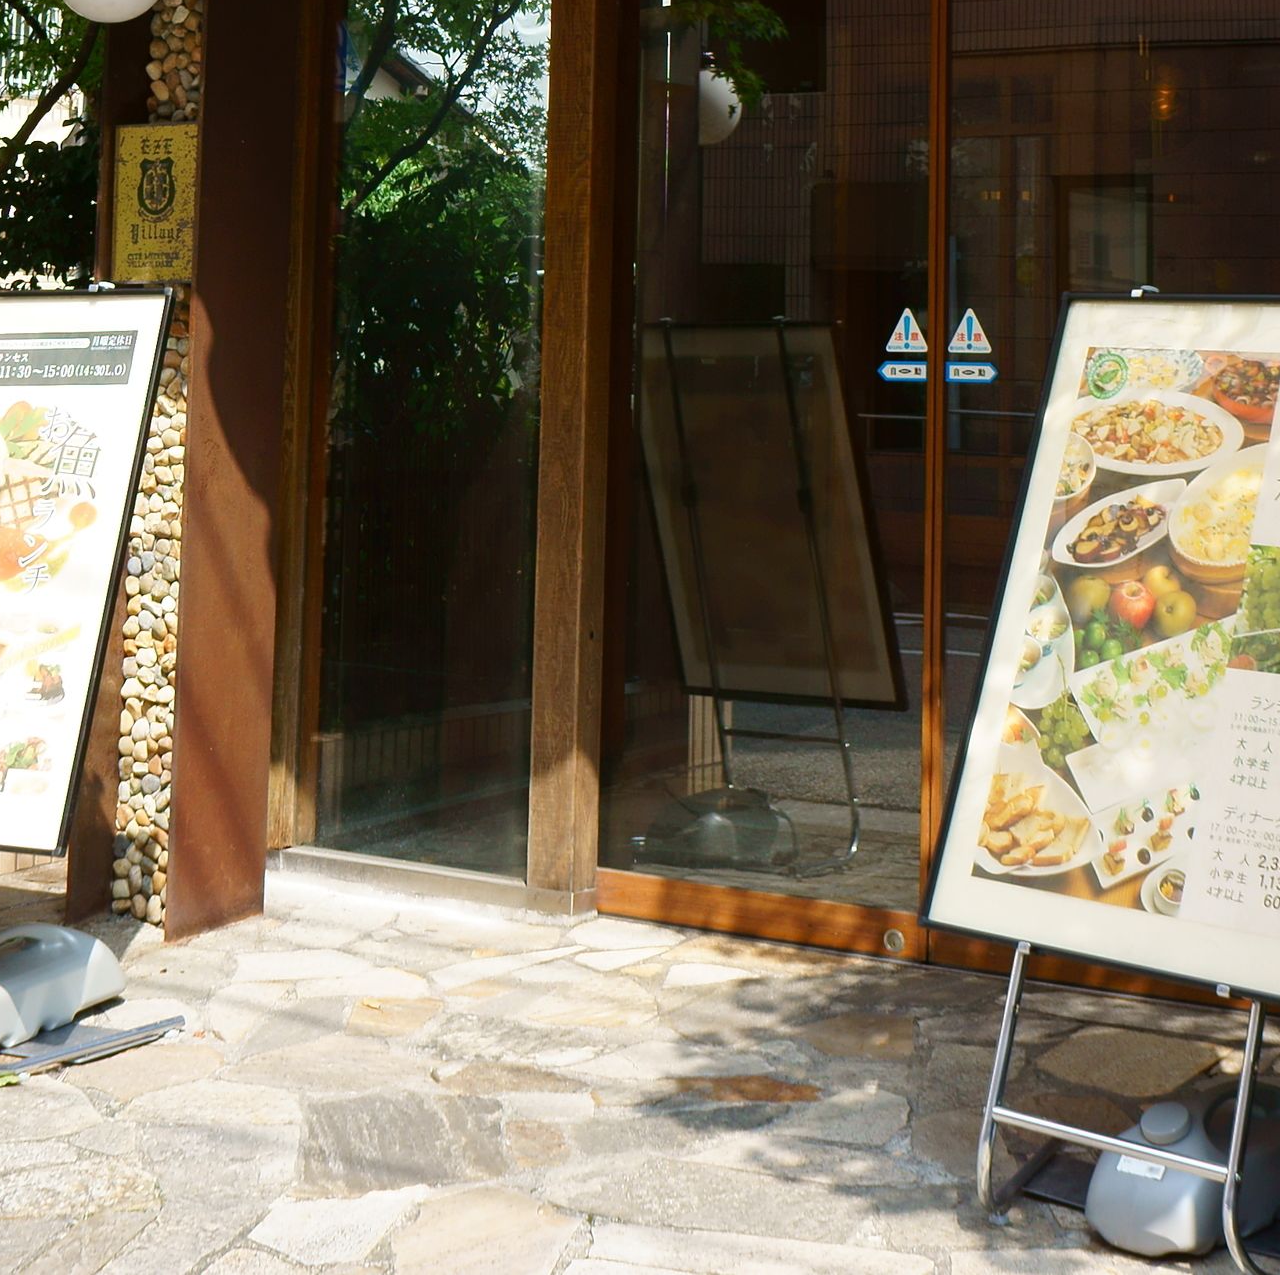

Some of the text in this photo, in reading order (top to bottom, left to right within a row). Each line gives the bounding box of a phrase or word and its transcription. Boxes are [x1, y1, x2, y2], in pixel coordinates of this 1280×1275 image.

[1233, 755, 1270, 772] 小学生
[1230, 774, 1268, 790] 4才以上
[1209, 867, 1247, 885] 小学生
[1206, 886, 1244, 903] 4才以上
